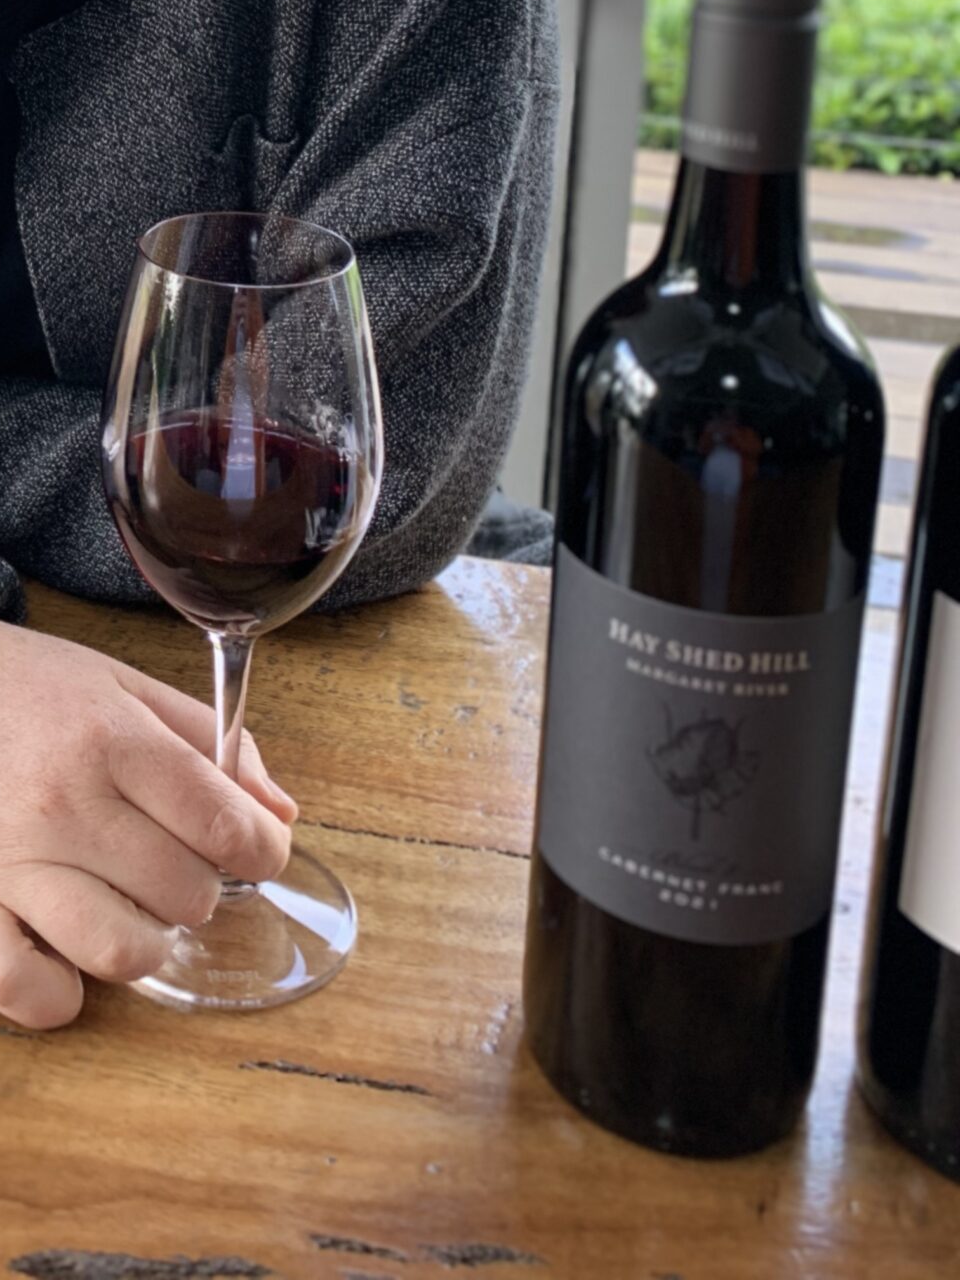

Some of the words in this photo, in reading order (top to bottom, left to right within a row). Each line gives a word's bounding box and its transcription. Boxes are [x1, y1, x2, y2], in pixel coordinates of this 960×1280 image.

[608, 616, 662, 656] HAY
[664, 638, 745, 673] SHED
[748, 650, 812, 675] HILL
[624, 656, 728, 696] MARGARET
[732, 681, 790, 697] RIVER
[597, 844, 708, 894] CABERNET
[657, 887, 720, 913] 2021
